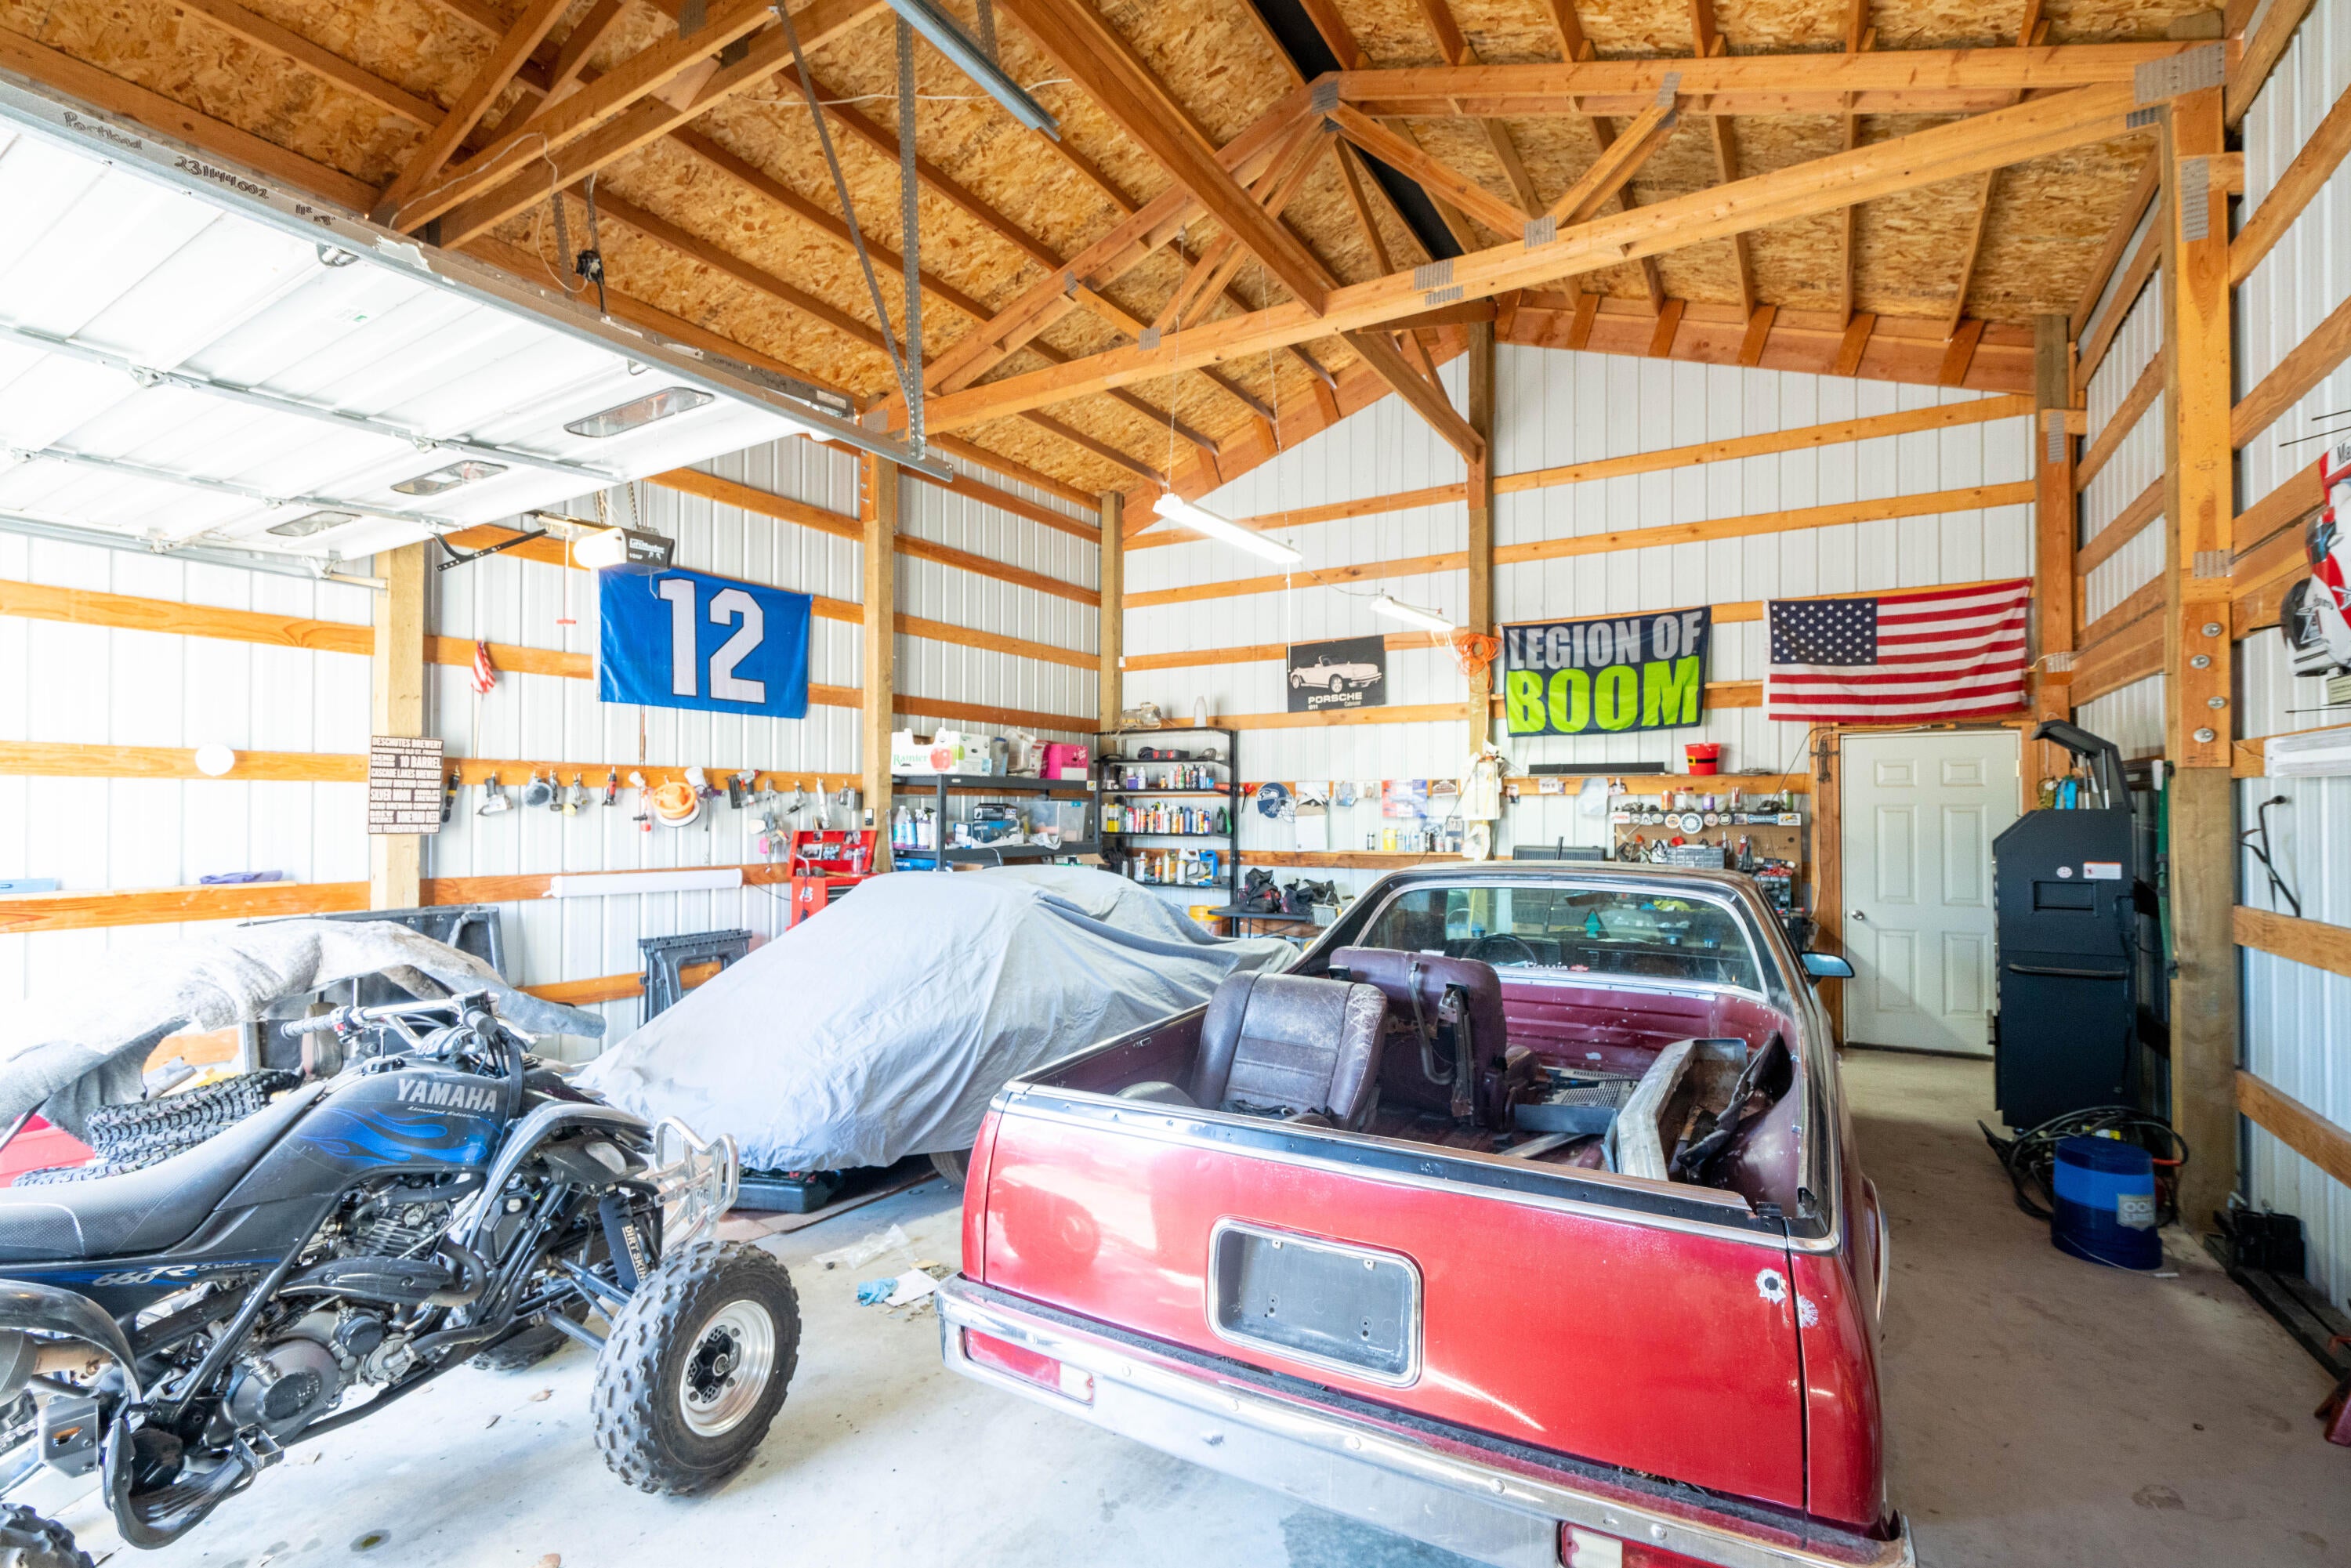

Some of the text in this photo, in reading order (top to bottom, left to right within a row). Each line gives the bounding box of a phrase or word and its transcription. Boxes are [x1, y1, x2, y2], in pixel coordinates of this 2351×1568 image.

[658, 577, 766, 704] 12
[1509, 610, 1703, 670] LEGION OF
[1308, 691, 1363, 704] PORSCHE
[1507, 655, 1700, 733] BOOM
[411, 739, 442, 748] BREWERY
[400, 755, 441, 769] 10 BARREL
[397, 769, 415, 778] LAKES
[371, 789, 392, 801] SILVER
[397, 1077, 498, 1113] YAMAHA
[408, 1106, 480, 1120] Limited Edition
[625, 1224, 640, 1251] DIRT
